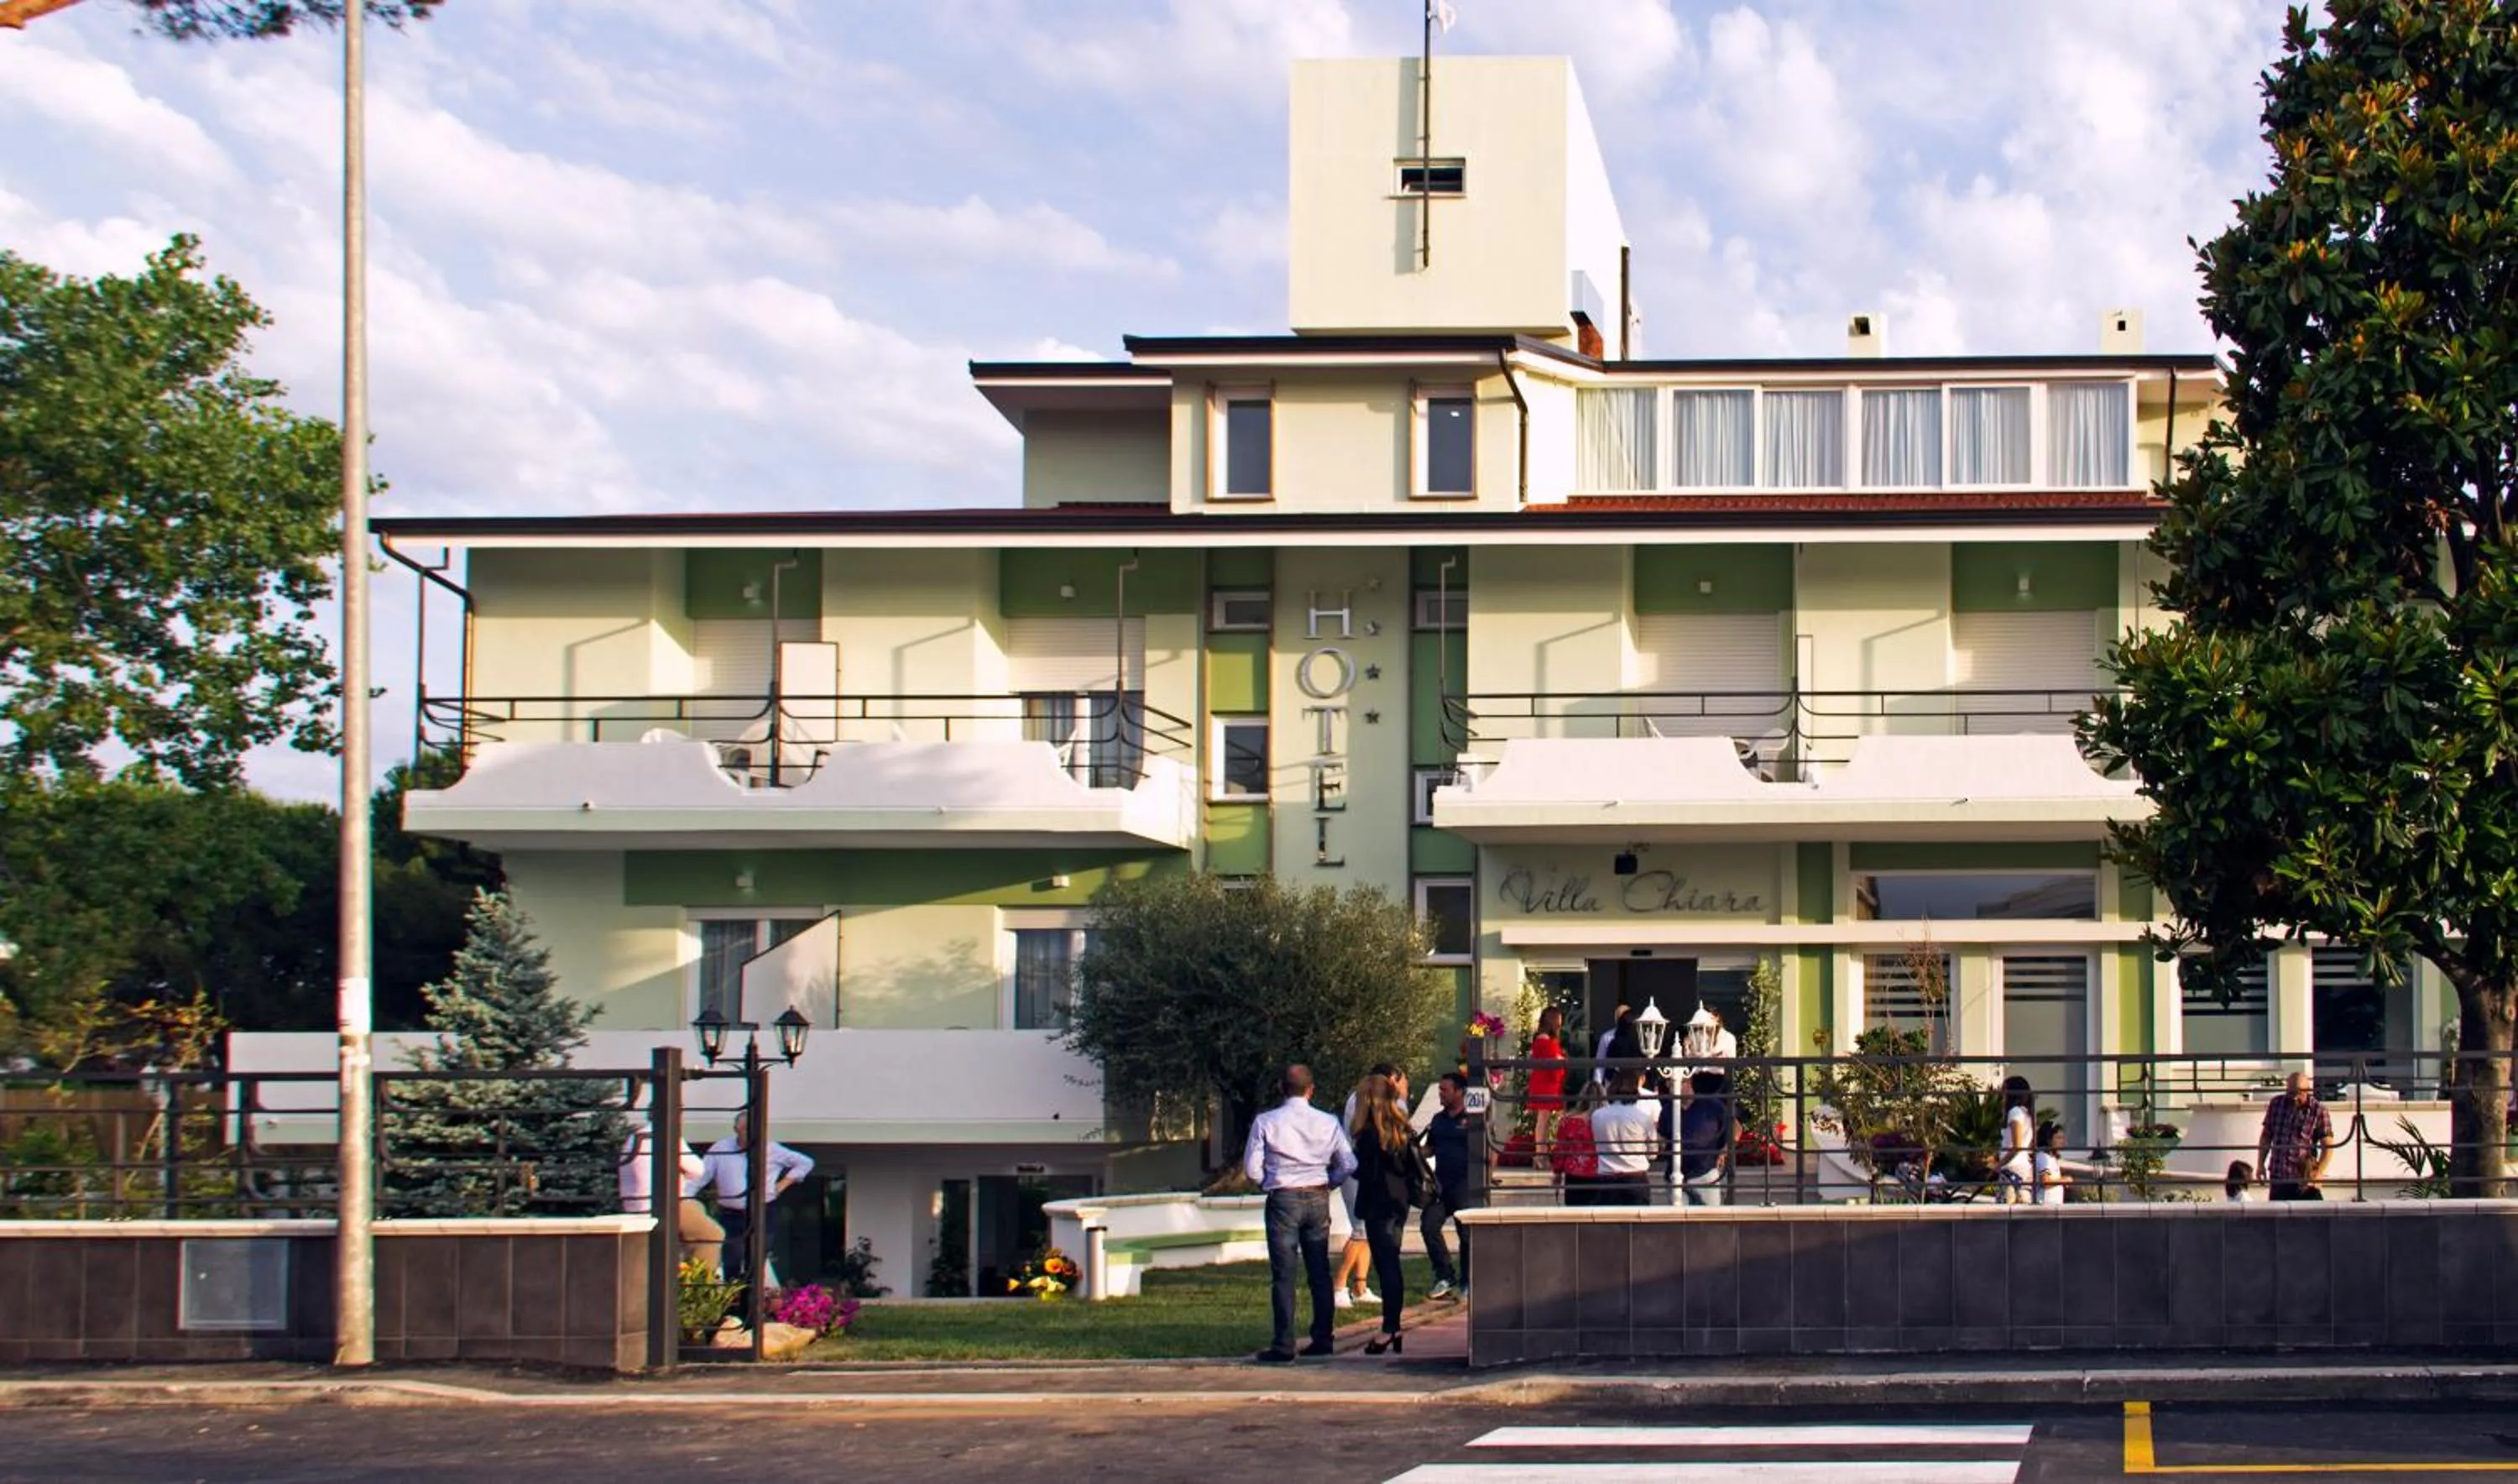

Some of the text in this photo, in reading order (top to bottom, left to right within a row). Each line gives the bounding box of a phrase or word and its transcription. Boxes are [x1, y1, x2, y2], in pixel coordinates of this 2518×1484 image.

[1298, 590, 1357, 867] HOTEL
[1500, 865, 1765, 913] Villa Chiara
